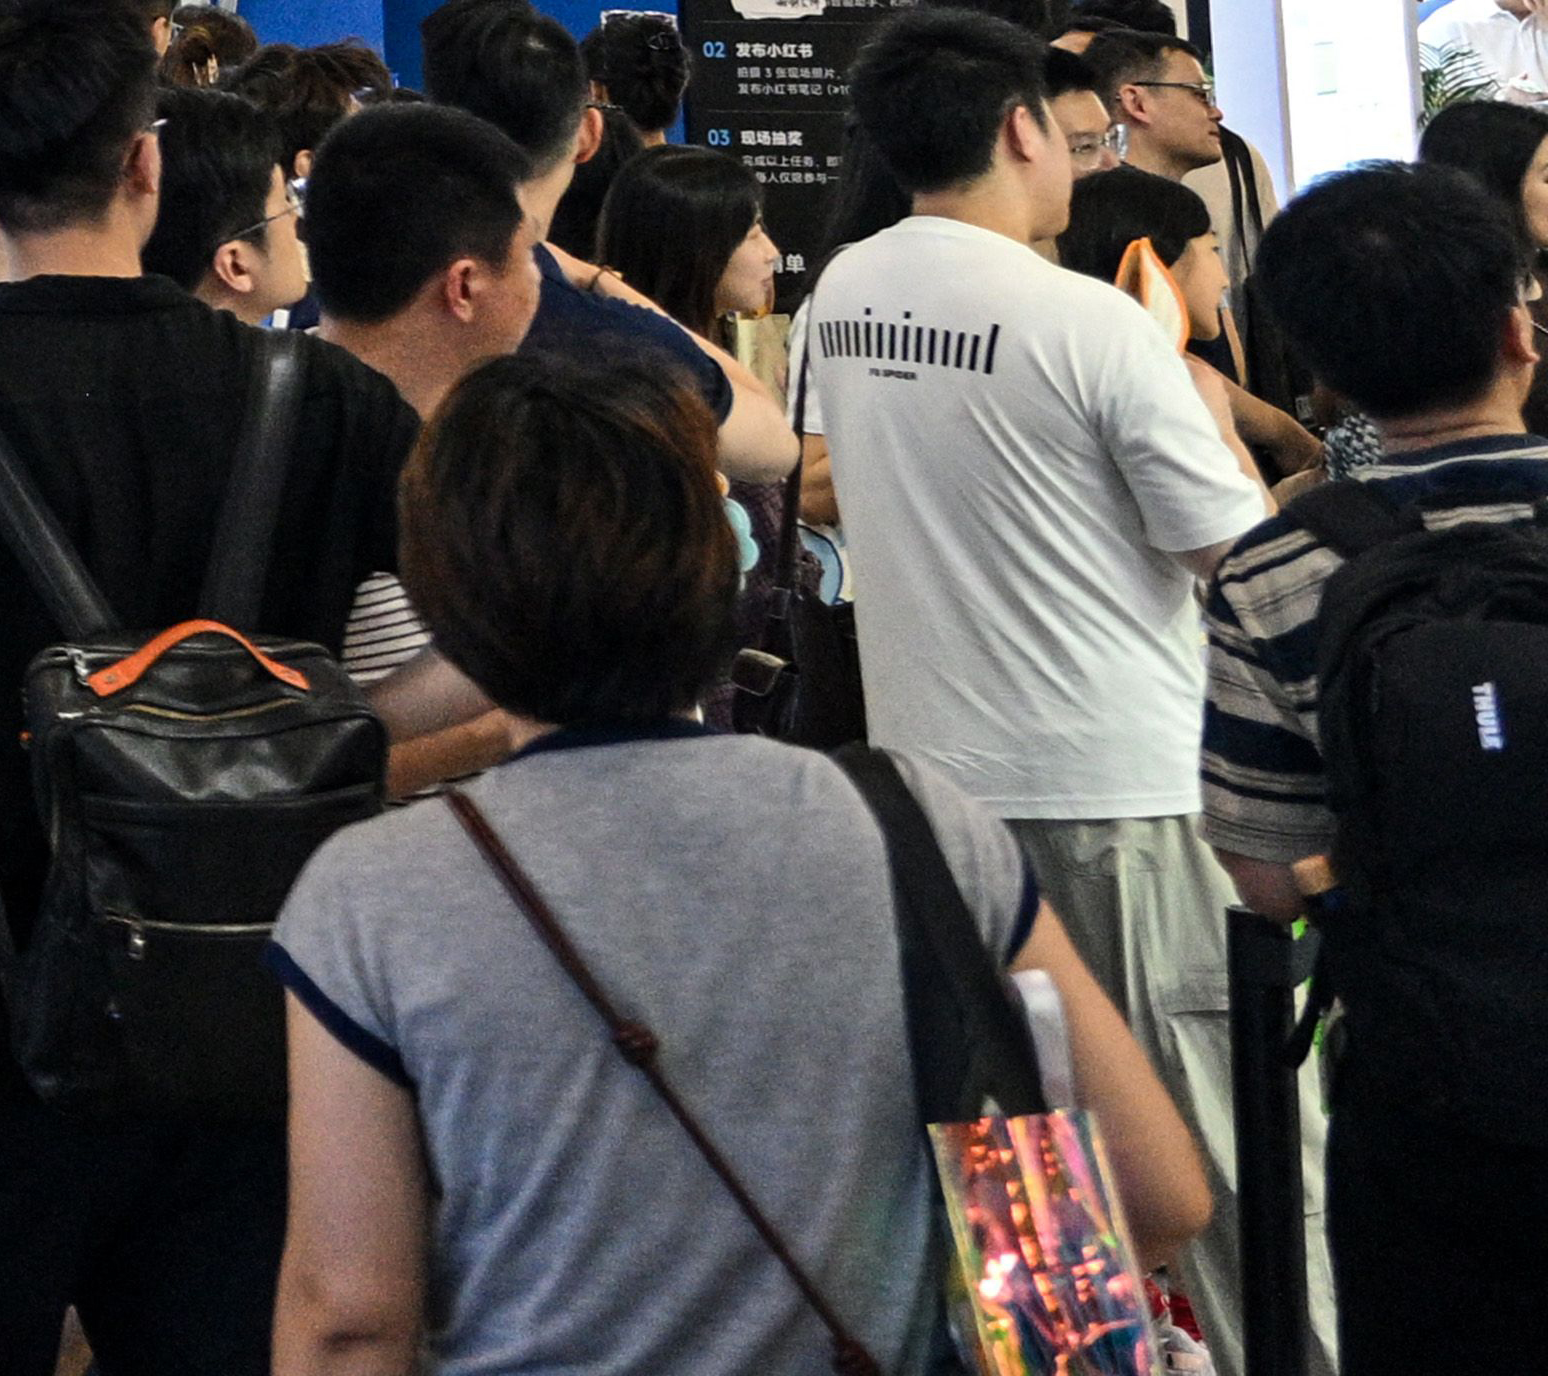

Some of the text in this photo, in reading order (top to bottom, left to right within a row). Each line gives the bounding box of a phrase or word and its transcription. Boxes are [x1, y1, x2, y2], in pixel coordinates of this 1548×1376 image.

[703, 42, 726, 58] 02
[735, 43, 813, 58] 发布小红书
[708, 130, 730, 145] 03
[1471, 681, 1504, 750] THULE
